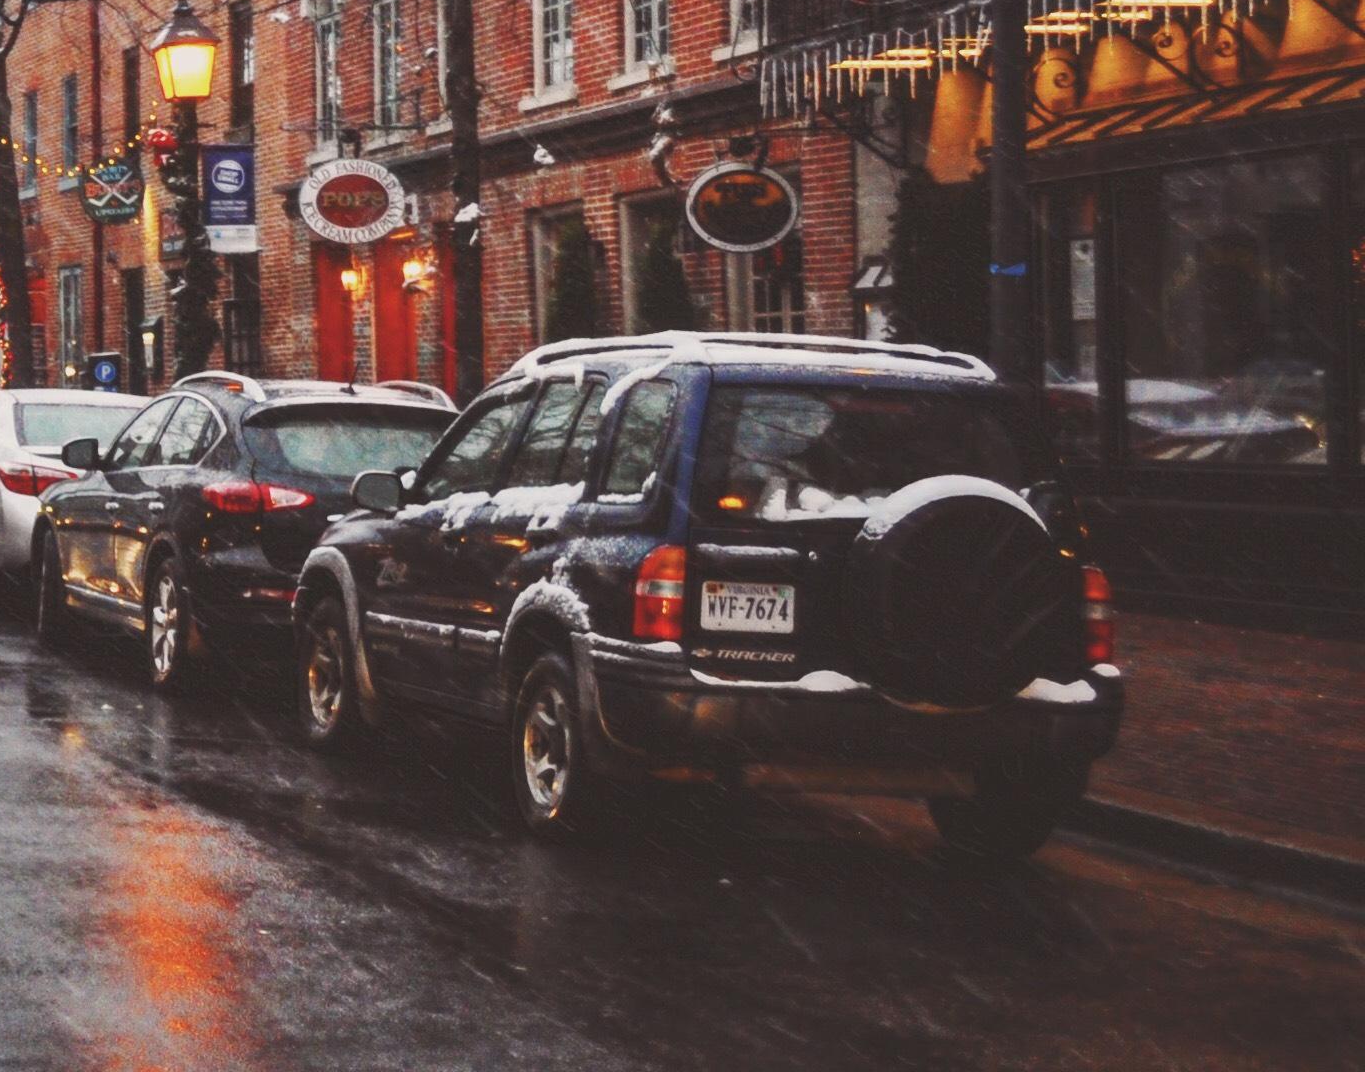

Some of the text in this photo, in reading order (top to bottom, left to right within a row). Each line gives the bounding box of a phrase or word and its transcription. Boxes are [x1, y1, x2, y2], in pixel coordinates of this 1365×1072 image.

[309, 162, 397, 190] OLD FASHIONED
[302, 201, 317, 220] ICE
[313, 217, 354, 242] CREAM
[102, 365, 111, 380] P
[726, 584, 771, 596] VIRGINIA
[707, 595, 789, 622] WVF-7674
[717, 649, 795, 663] TRACKER
